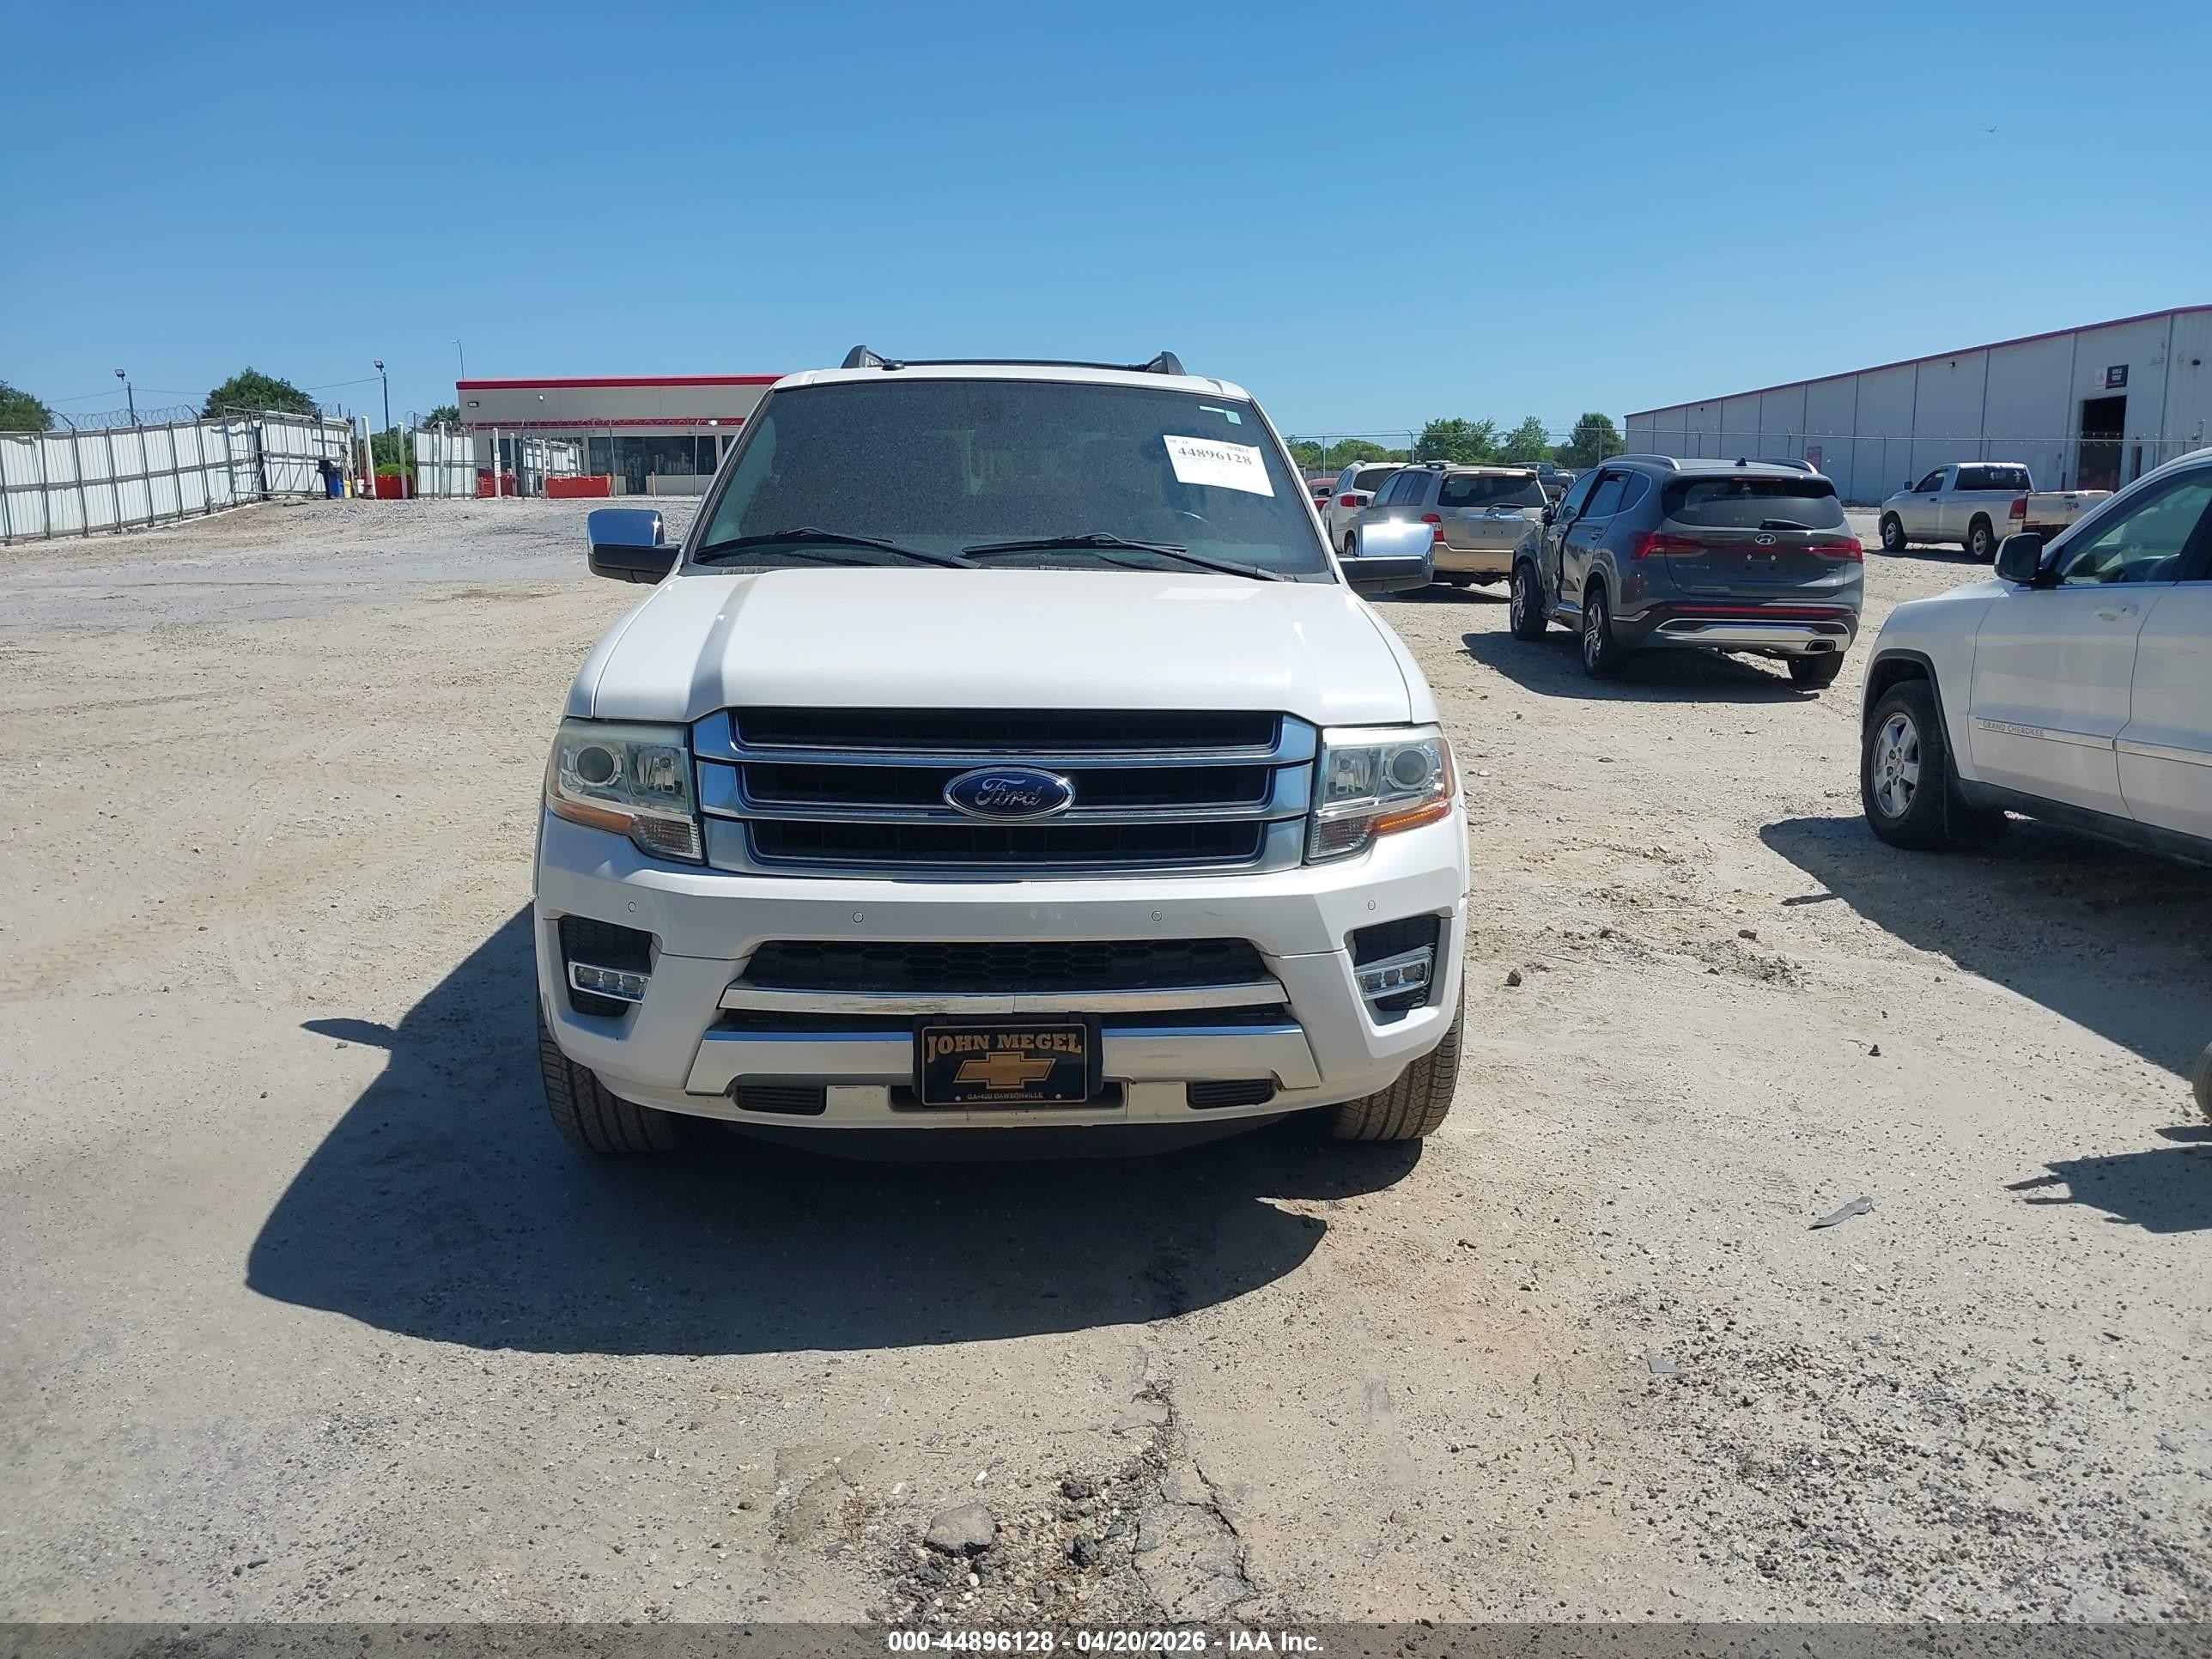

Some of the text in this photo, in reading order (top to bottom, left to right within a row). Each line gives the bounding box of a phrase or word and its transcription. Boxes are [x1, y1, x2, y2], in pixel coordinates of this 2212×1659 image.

[1177, 447, 1252, 465] 44896128
[1983, 721, 2044, 737] GRAND CHEROKEE
[974, 778, 1042, 805] Ford
[927, 1033, 1082, 1063] JOHN MEGEL
